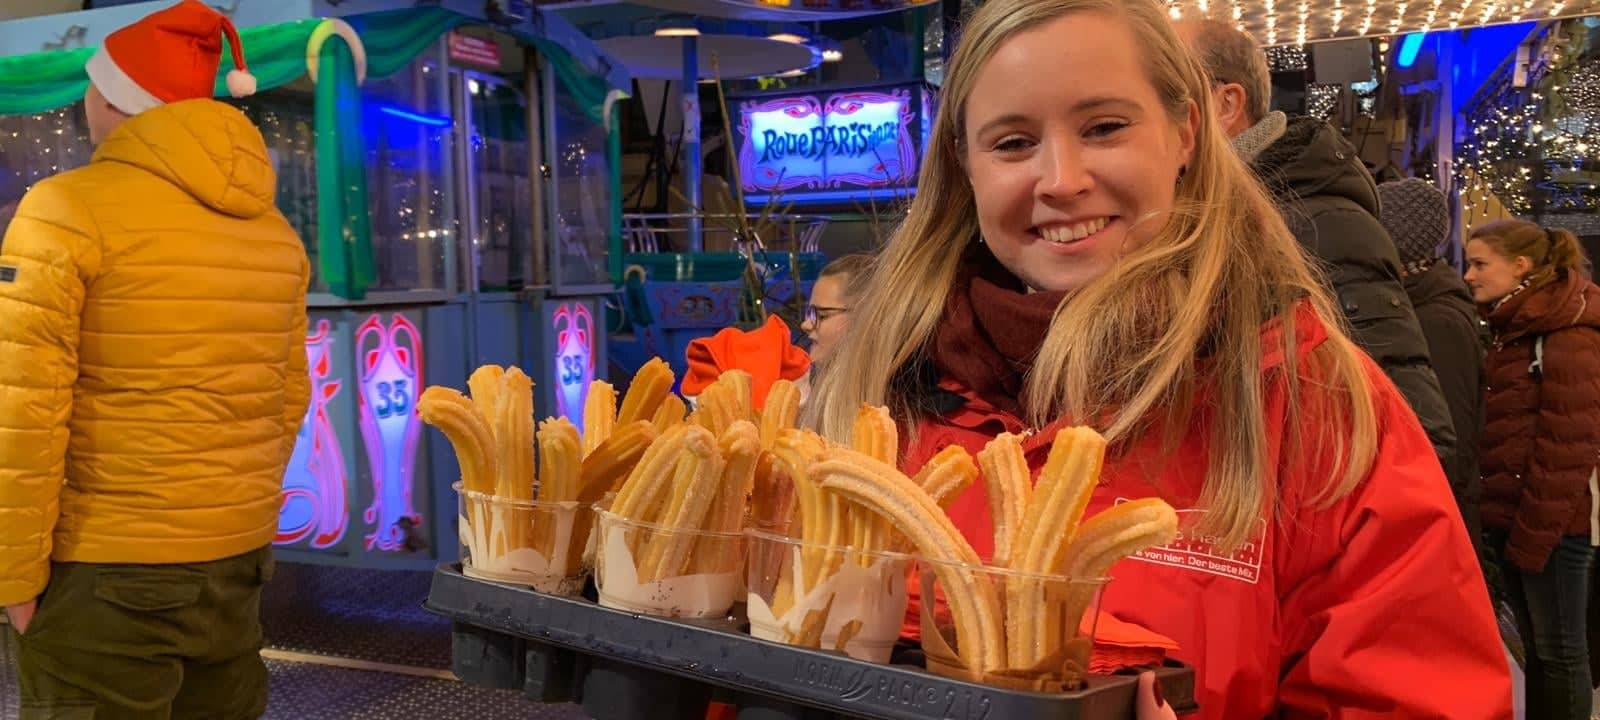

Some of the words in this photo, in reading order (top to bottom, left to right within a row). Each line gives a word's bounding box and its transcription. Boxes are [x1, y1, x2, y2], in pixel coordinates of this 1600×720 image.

[563, 355, 584, 385] 35
[376, 379, 408, 417] 35
[1145, 551, 1162, 560] von
[1188, 556, 1207, 567] Der
[1209, 560, 1237, 574] beste
